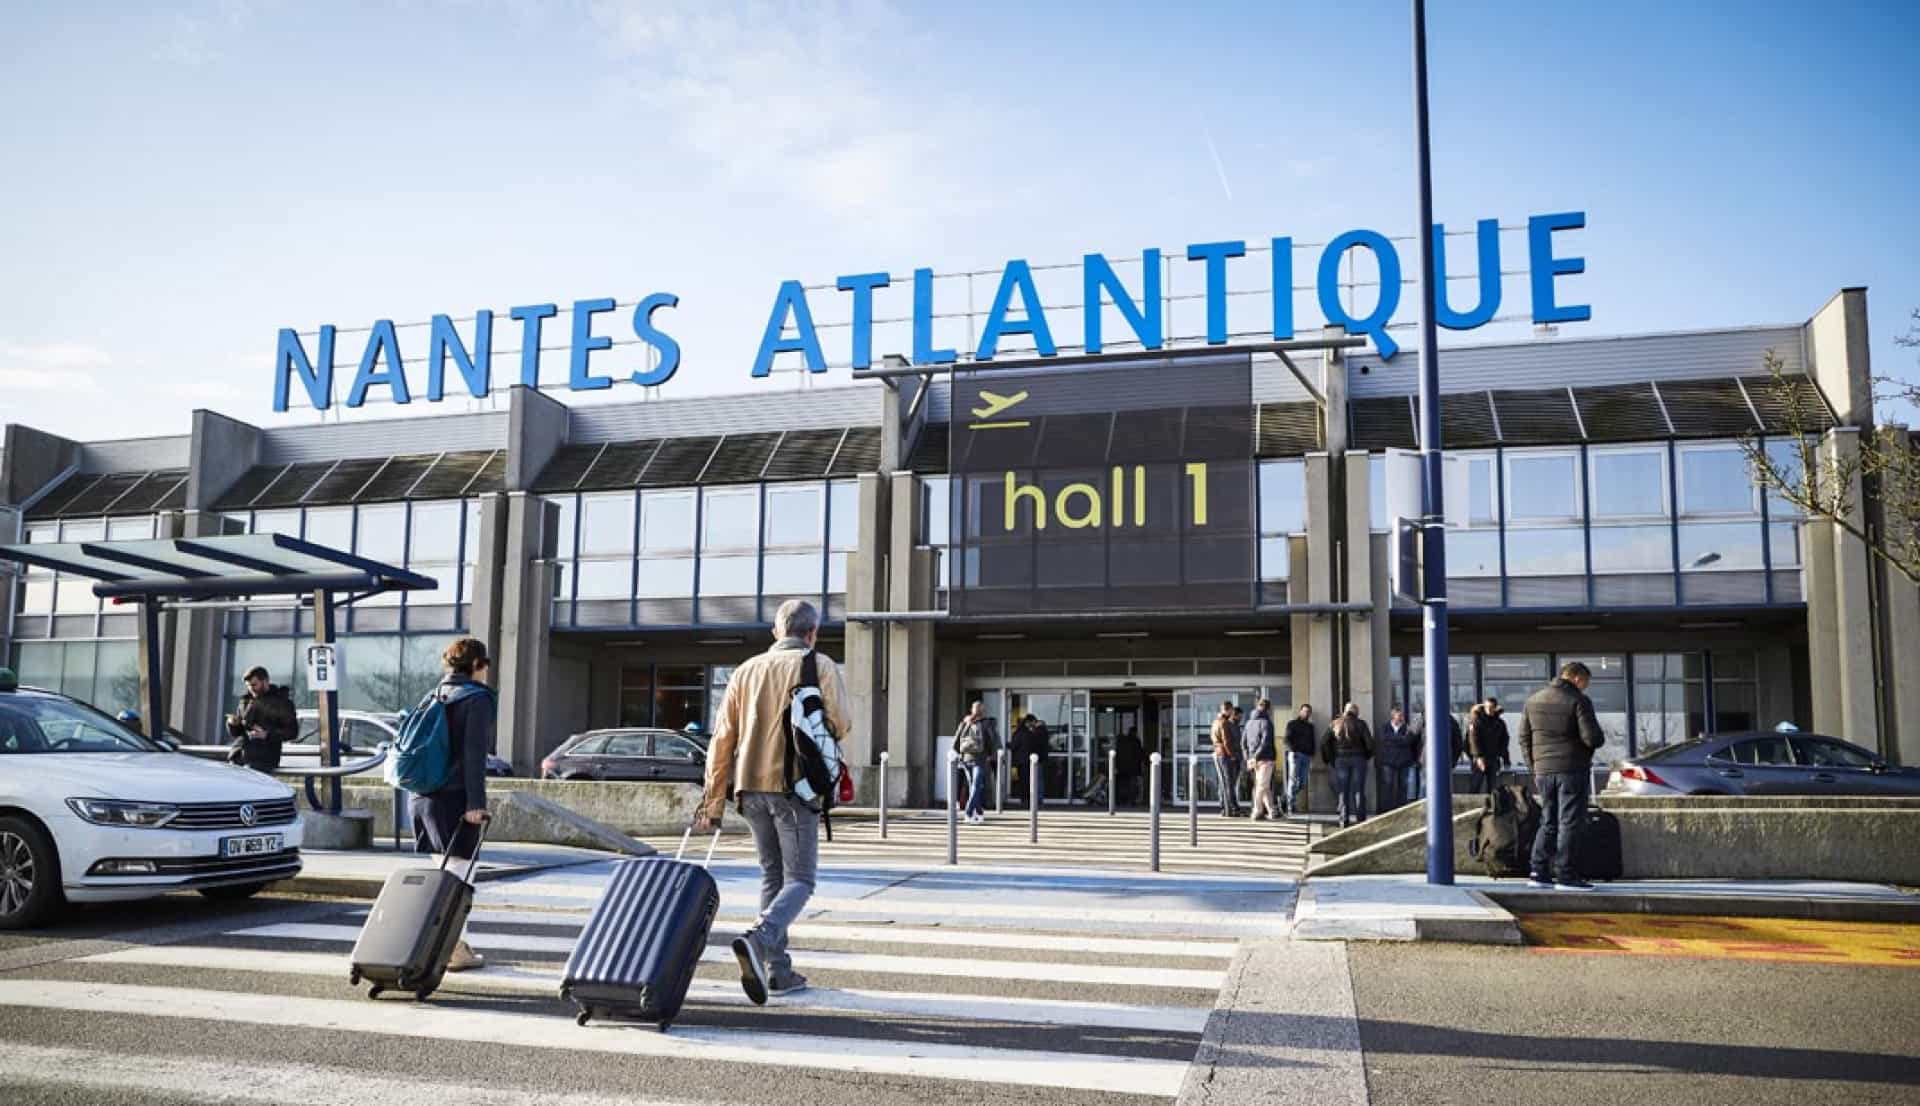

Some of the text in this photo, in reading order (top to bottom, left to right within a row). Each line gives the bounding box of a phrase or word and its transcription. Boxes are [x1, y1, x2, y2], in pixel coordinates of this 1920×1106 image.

[273, 211, 1592, 411] NANTES ATLANTIQUE
[1004, 463, 1208, 530] hall 1
